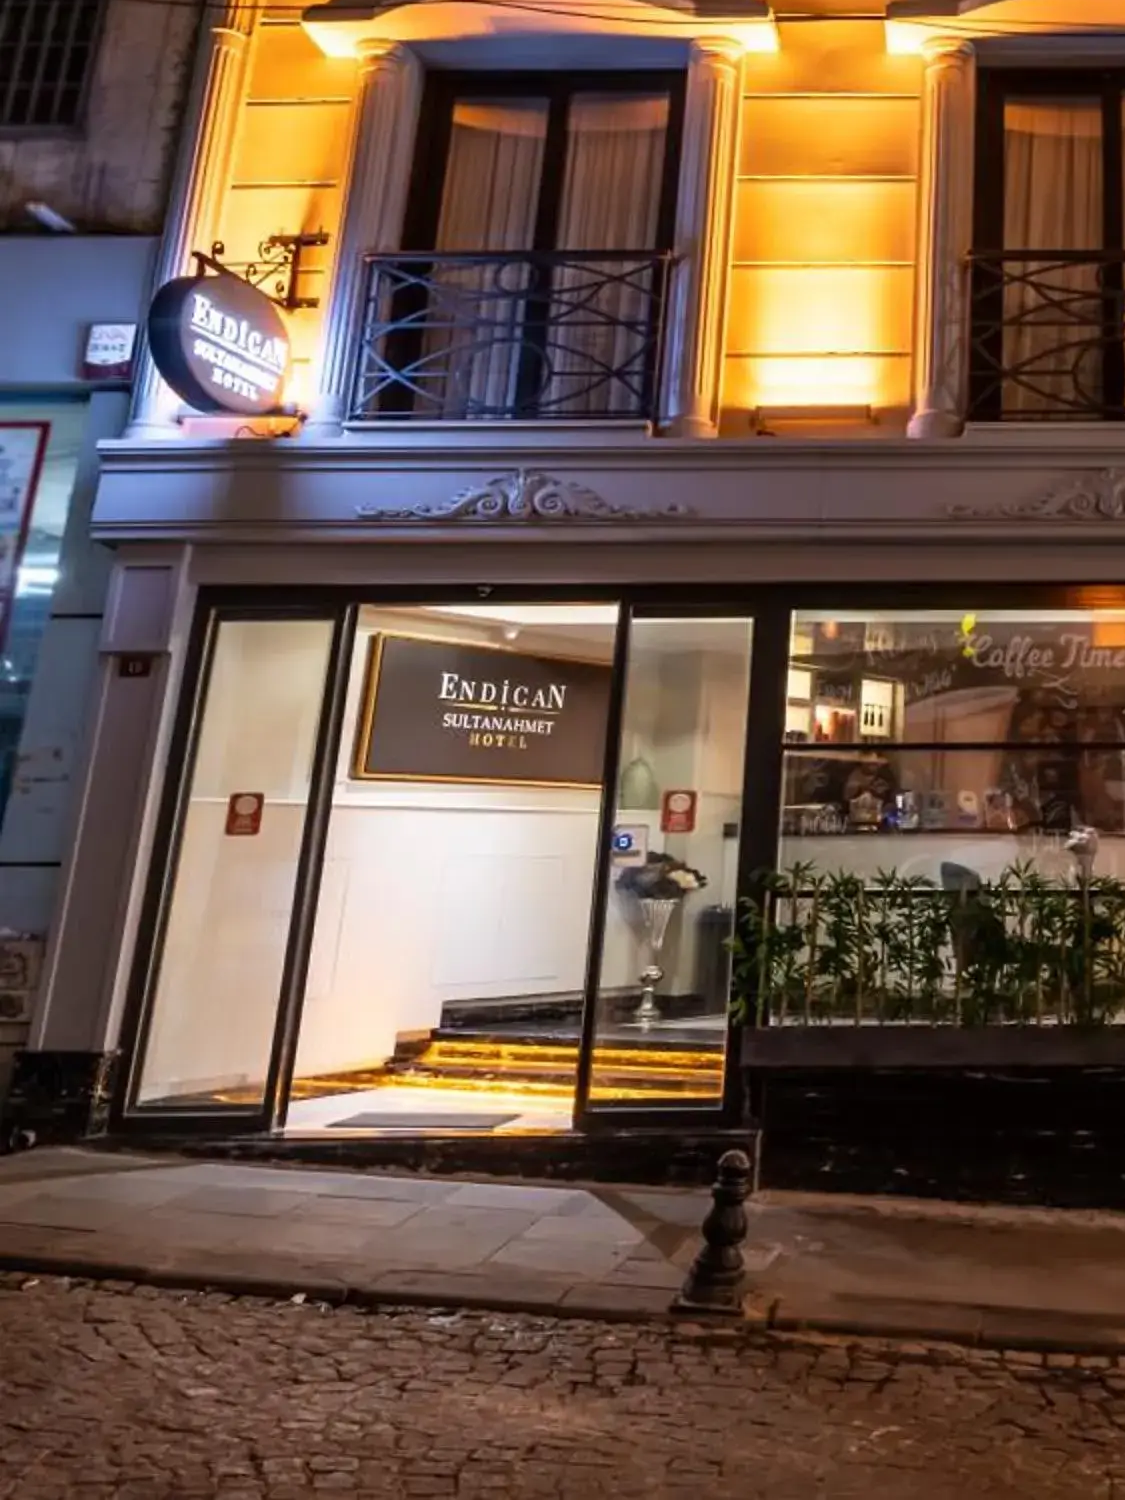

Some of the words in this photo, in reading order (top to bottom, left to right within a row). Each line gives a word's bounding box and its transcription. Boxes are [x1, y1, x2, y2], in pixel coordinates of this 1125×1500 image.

[967, 634, 1055, 679] Coffee
[442, 711, 556, 736] SULTANAHMET
[468, 731, 528, 750] HOTEL
